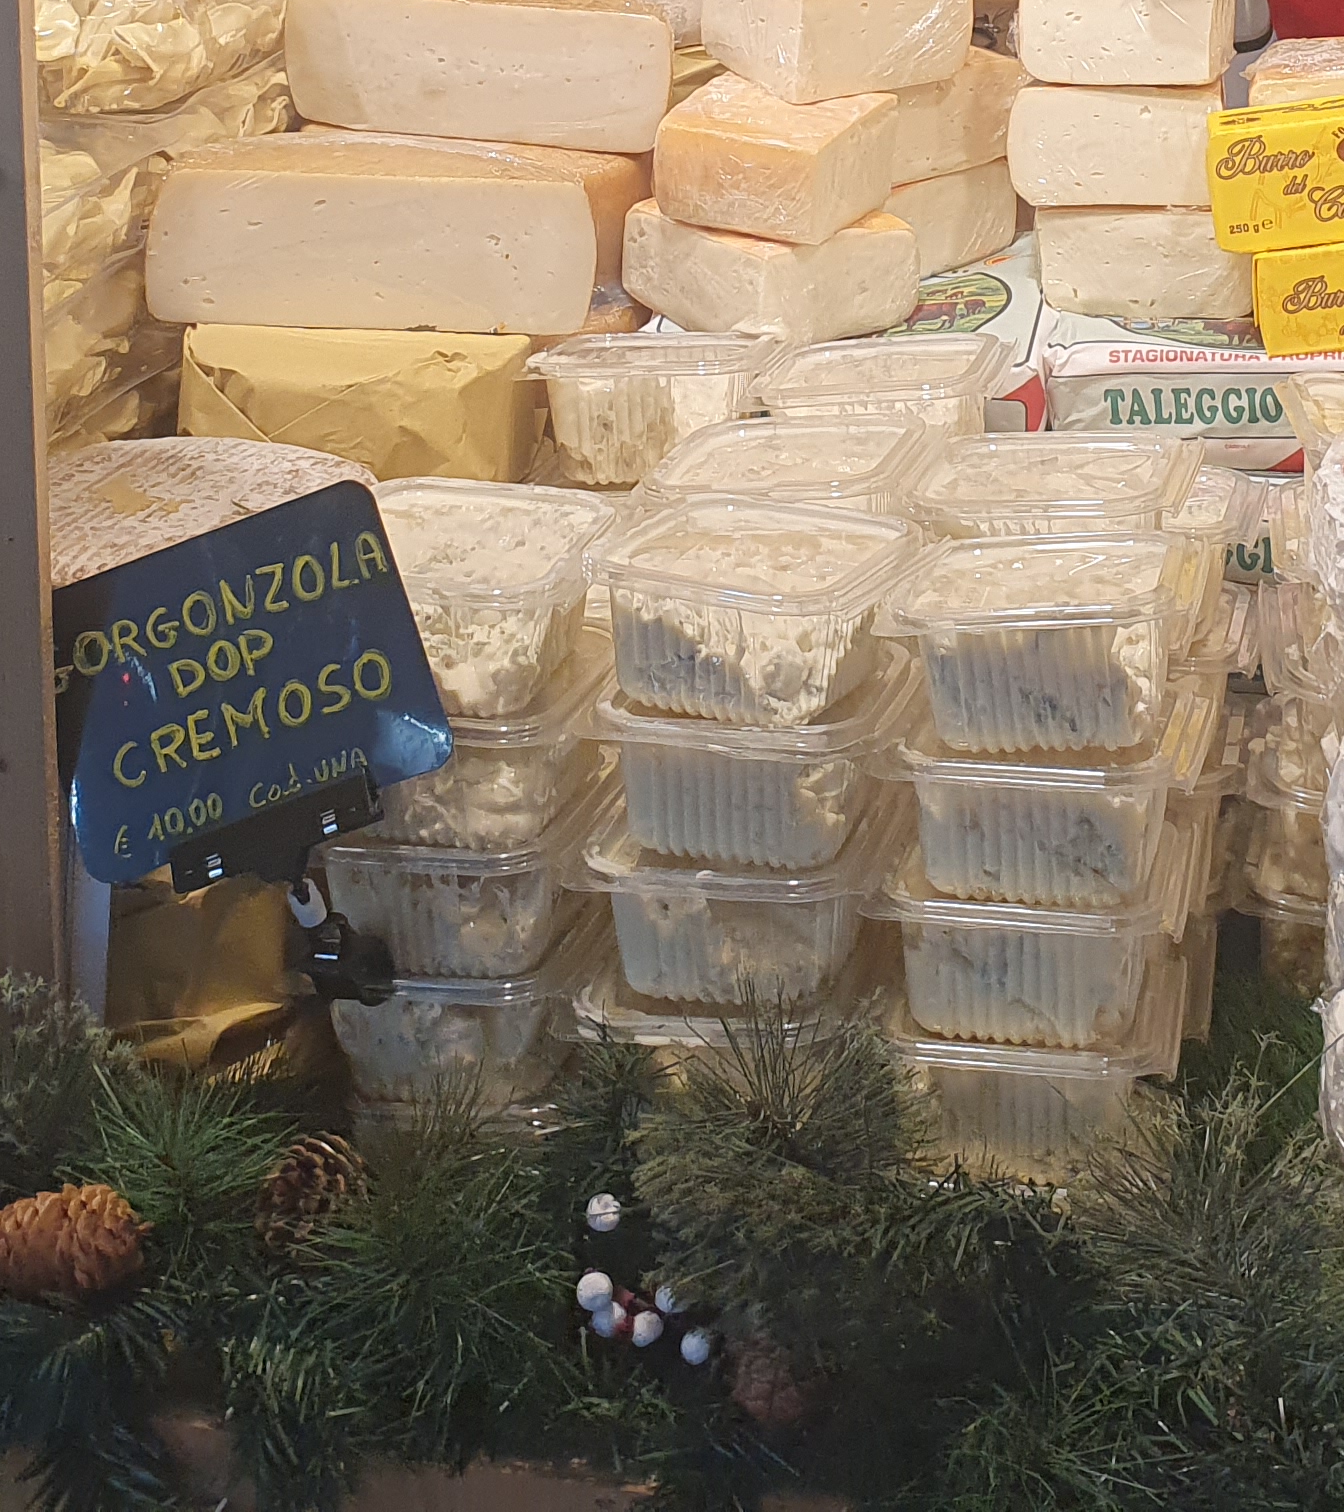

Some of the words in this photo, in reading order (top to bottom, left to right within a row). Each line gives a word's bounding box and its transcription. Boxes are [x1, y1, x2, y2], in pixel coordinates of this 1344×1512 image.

[1216, 135, 1316, 180] Burro
[1283, 173, 1309, 196] del
[1228, 223, 1250, 235] 250
[1104, 387, 1284, 426] TALEGGIO
[168, 628, 274, 699] DOP
[112, 649, 392, 788] CREMOSO
